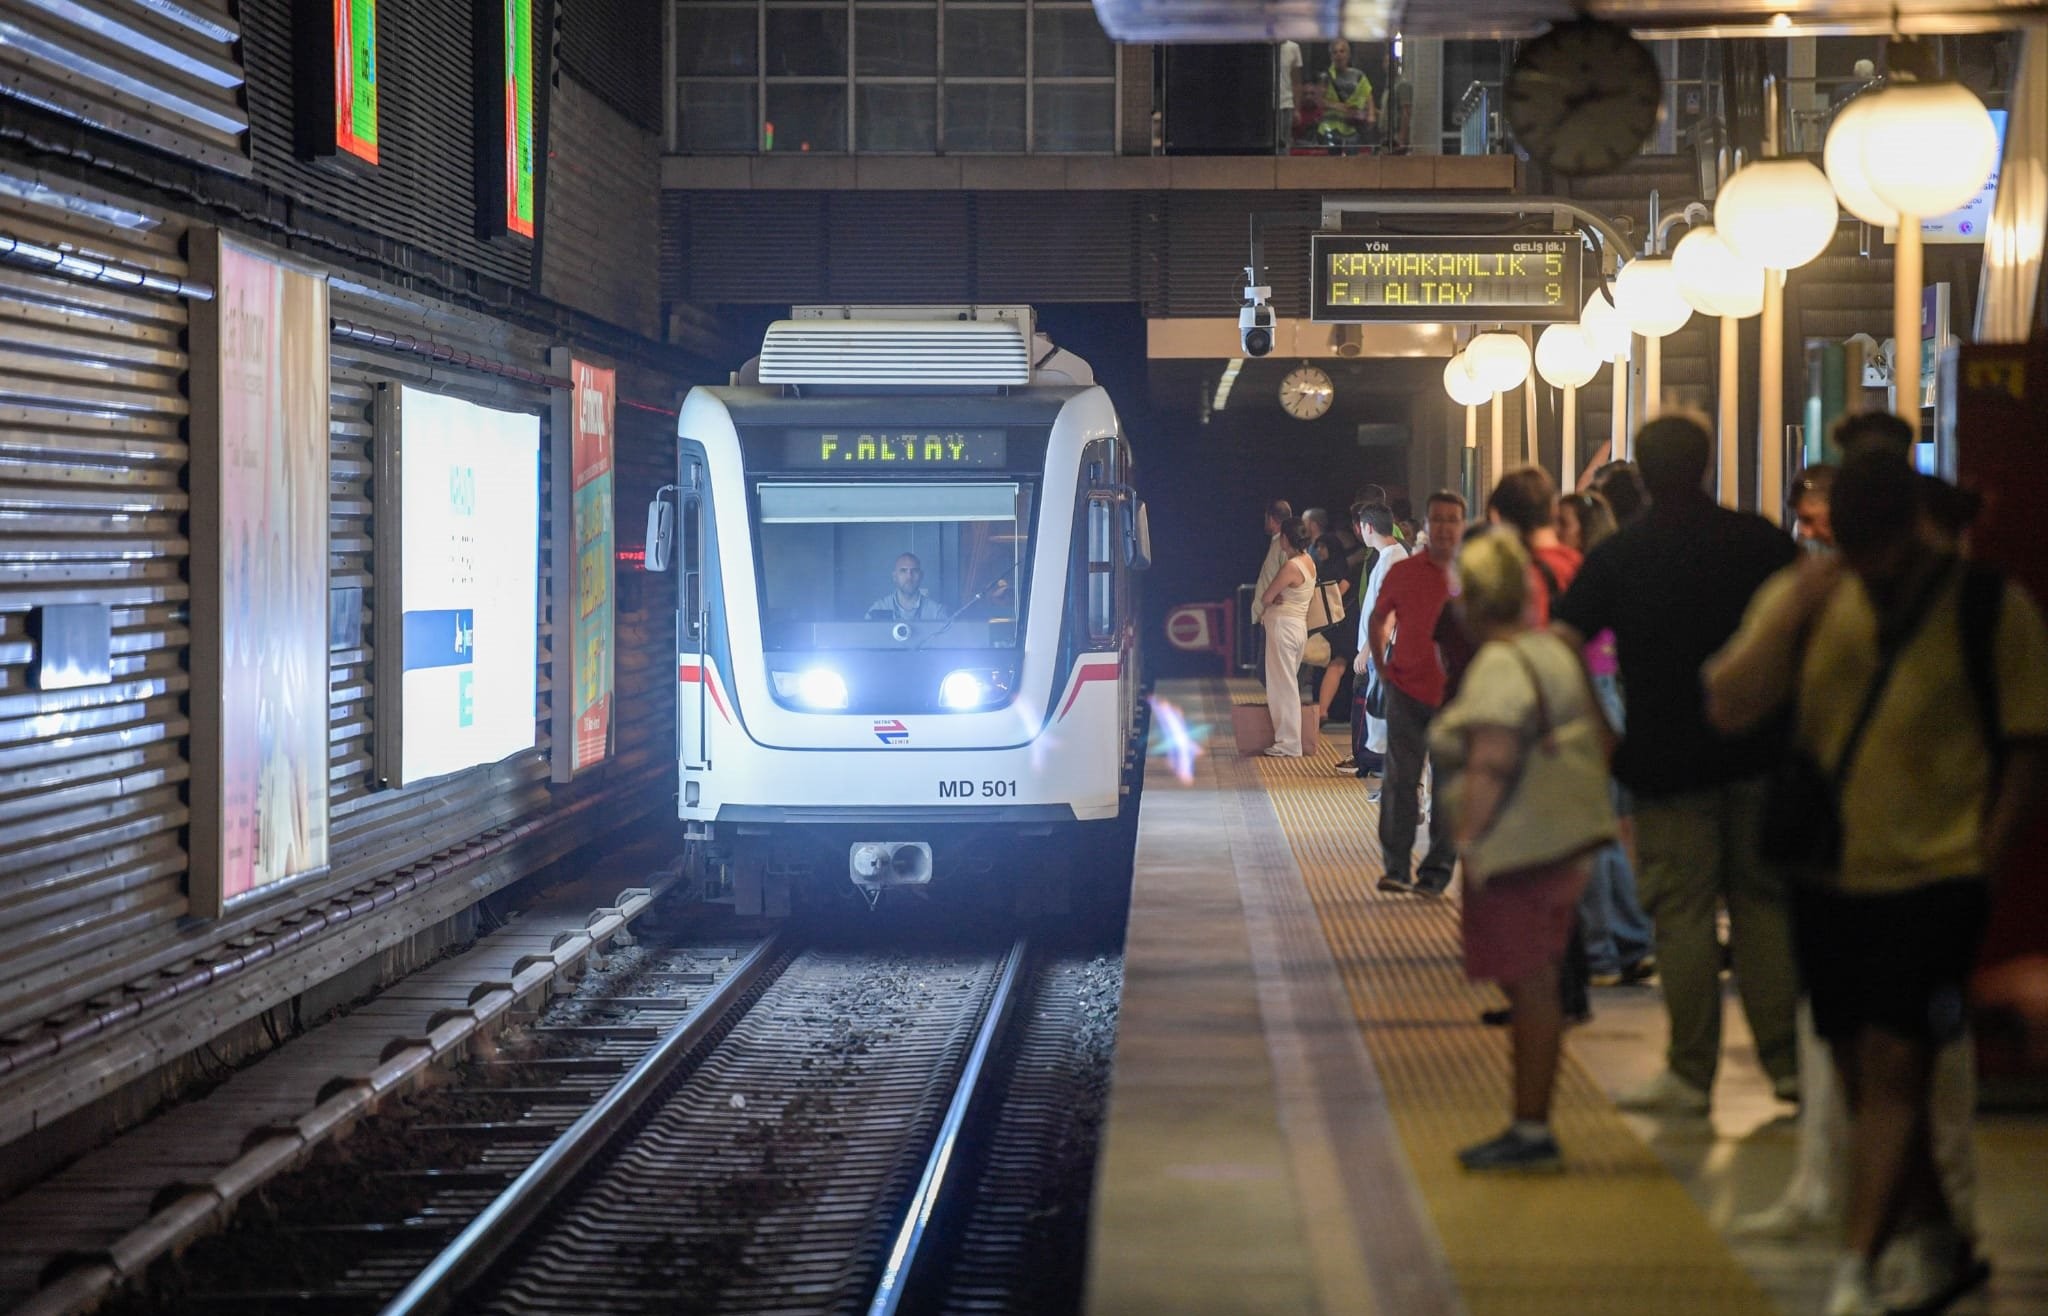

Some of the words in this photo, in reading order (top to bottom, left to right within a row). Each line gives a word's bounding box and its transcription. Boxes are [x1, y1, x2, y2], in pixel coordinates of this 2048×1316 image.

[1365, 241, 1389, 252] YÖN
[1513, 241, 1544, 253] GELİŞ
[1545, 241, 1566, 253] (dk.)
[1332, 253, 1526, 276] KAYMAKAMLIK
[1545, 253, 1562, 276] 5
[1332, 282, 1360, 305] F.
[1385, 282, 1473, 305] ALTAY
[1545, 282, 1561, 305] 9
[821, 434, 965, 460] F.ALTAY
[939, 780, 975, 798] MD
[981, 780, 1017, 798] 501
